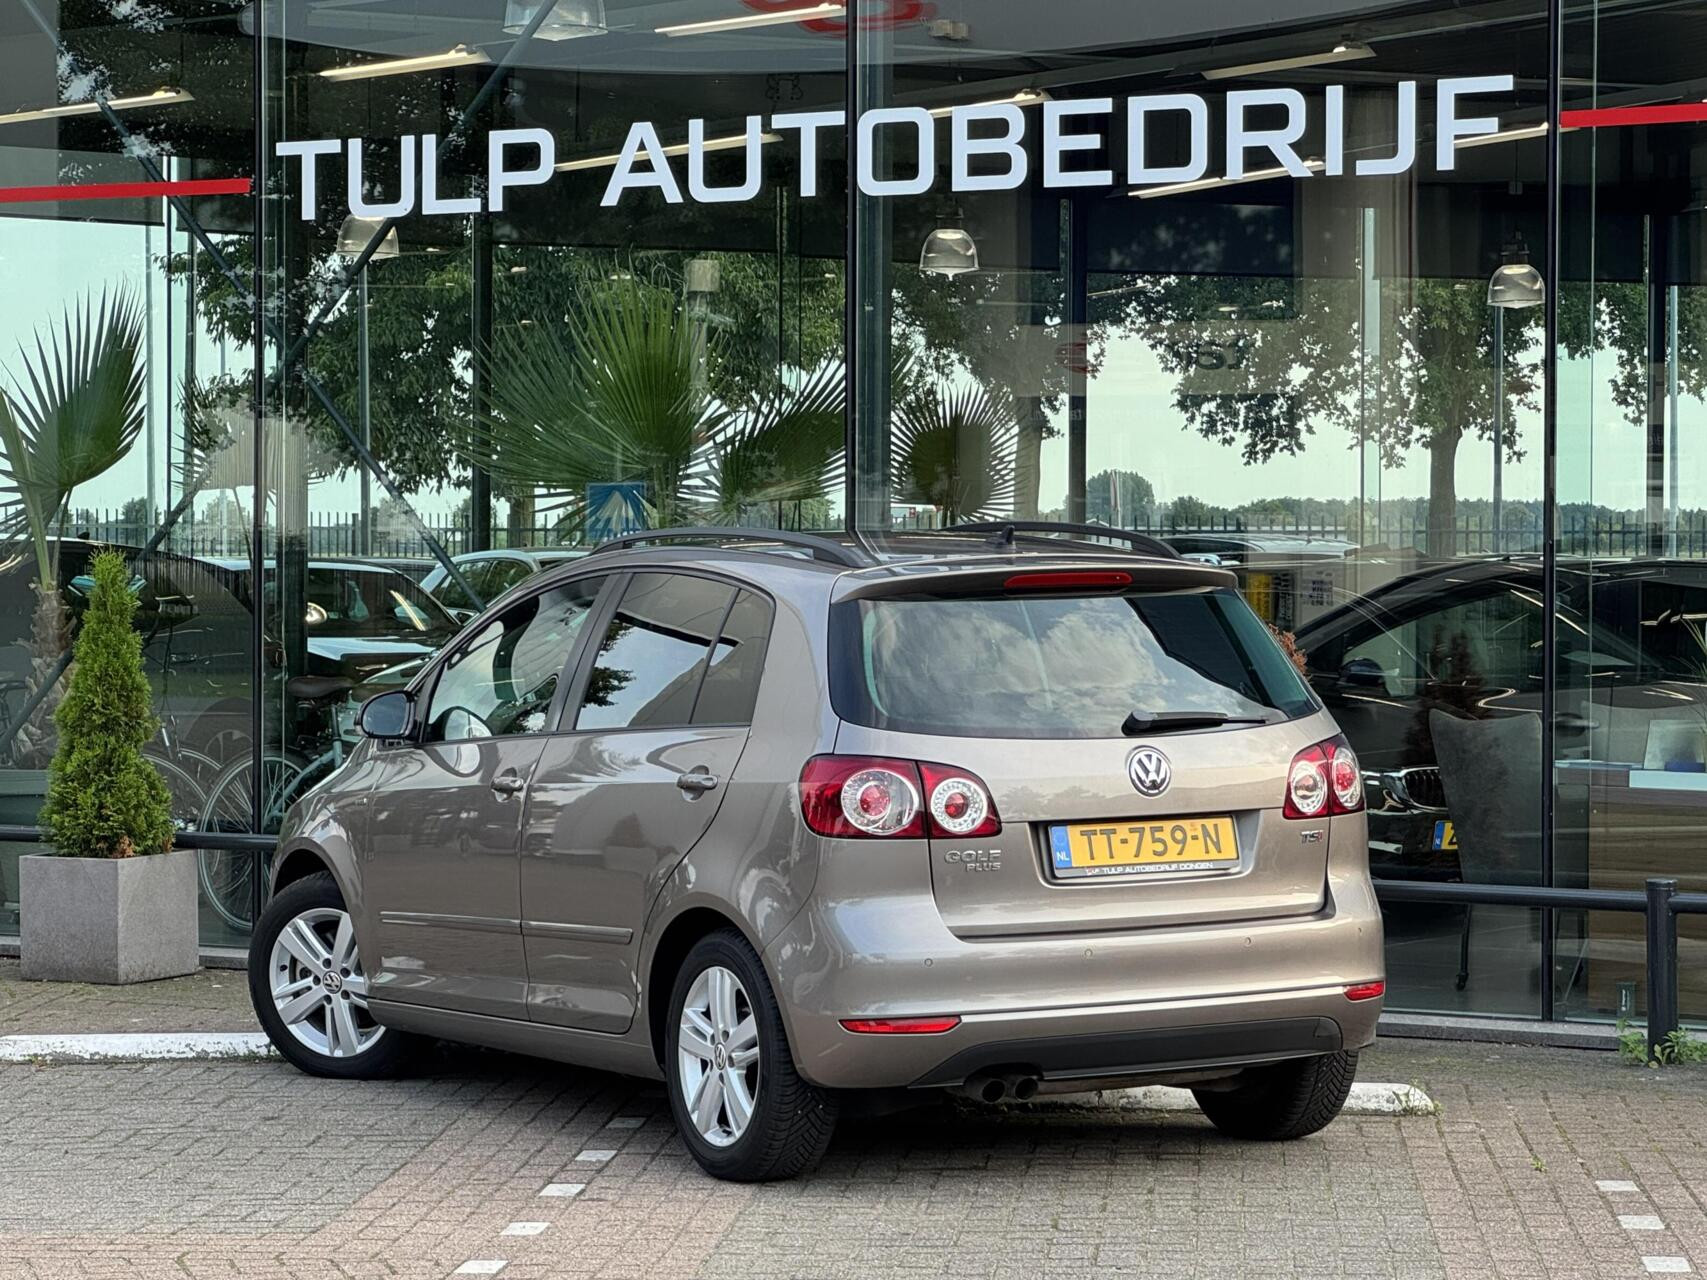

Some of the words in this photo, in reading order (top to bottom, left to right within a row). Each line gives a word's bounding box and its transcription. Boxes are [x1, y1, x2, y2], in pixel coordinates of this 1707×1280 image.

[276, 128, 555, 220] TULP
[600, 75, 1513, 206] AUTOBEDRIJF
[1080, 823, 1222, 860] TT-759-N
[944, 848, 1002, 864] GOLF
[1056, 850, 1069, 861] NL
[965, 862, 1002, 873] PLUS
[1102, 867, 1123, 875] TULP
